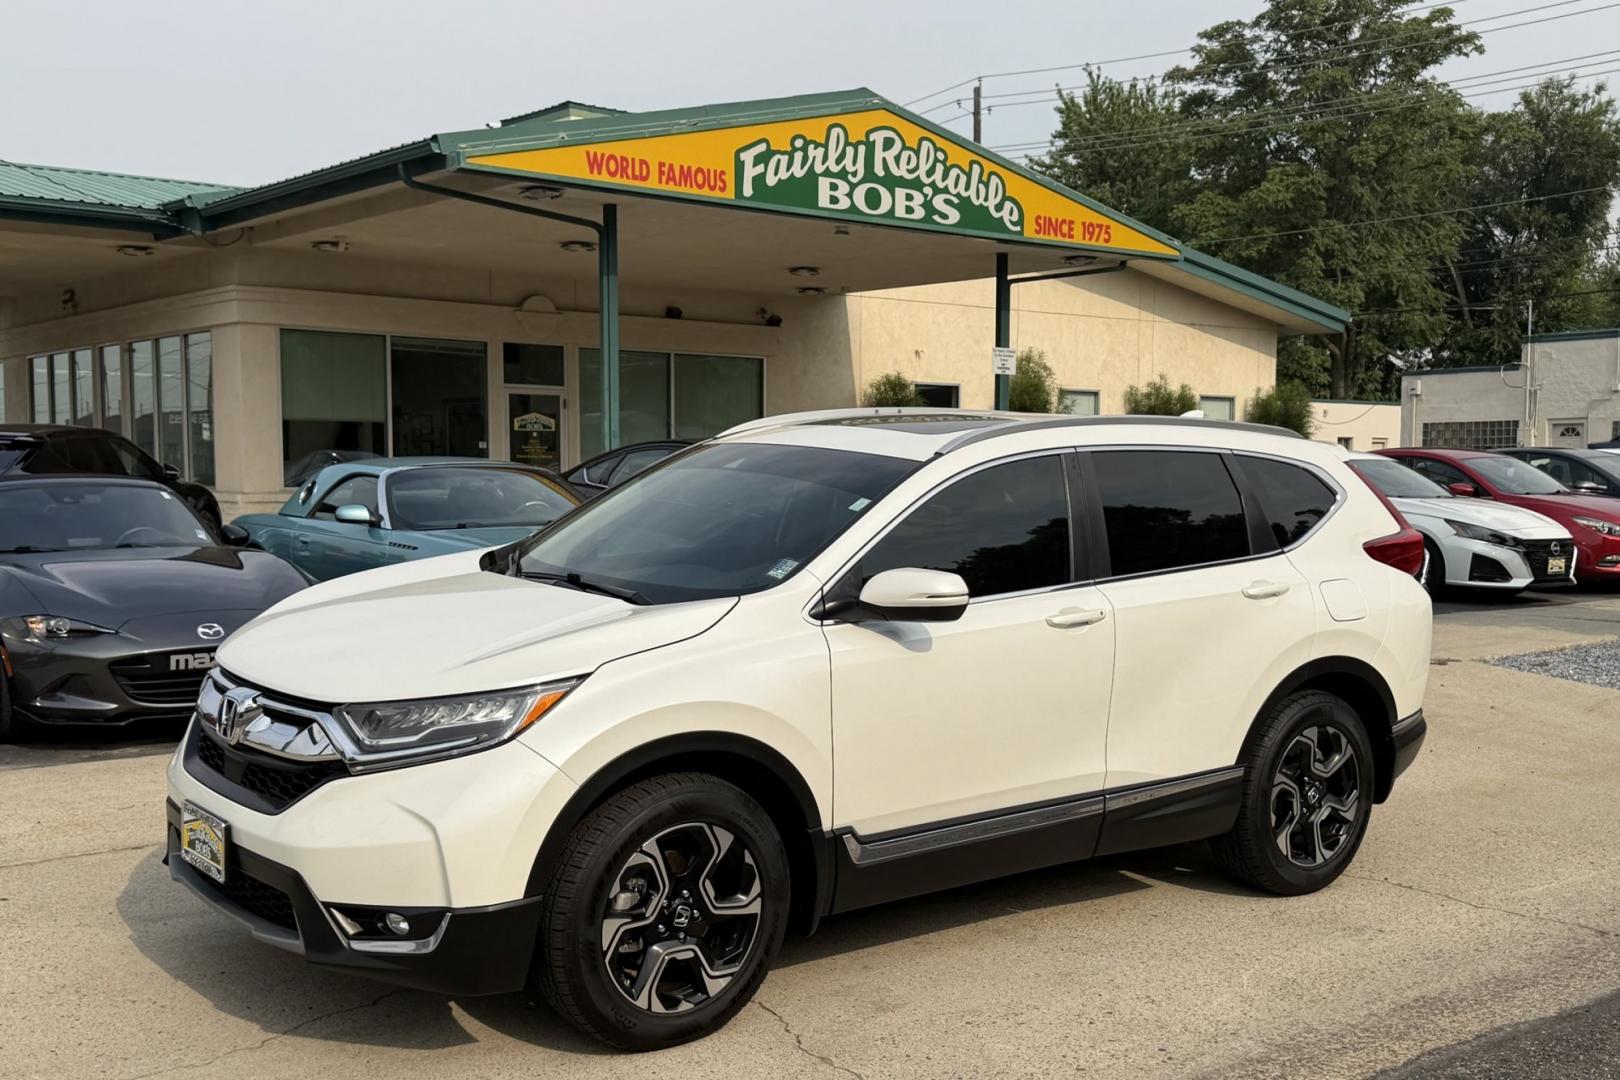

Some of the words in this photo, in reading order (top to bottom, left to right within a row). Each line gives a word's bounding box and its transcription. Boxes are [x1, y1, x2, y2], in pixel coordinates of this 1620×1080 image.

[585, 150, 650, 182] WORLD
[658, 162, 727, 193] FAMOUS
[740, 126, 865, 197] Fairly
[869, 129, 1021, 232] Reliable
[818, 176, 961, 225] BOB'S
[1034, 215, 1075, 239] SINCE
[1081, 221, 1112, 244] 1975
